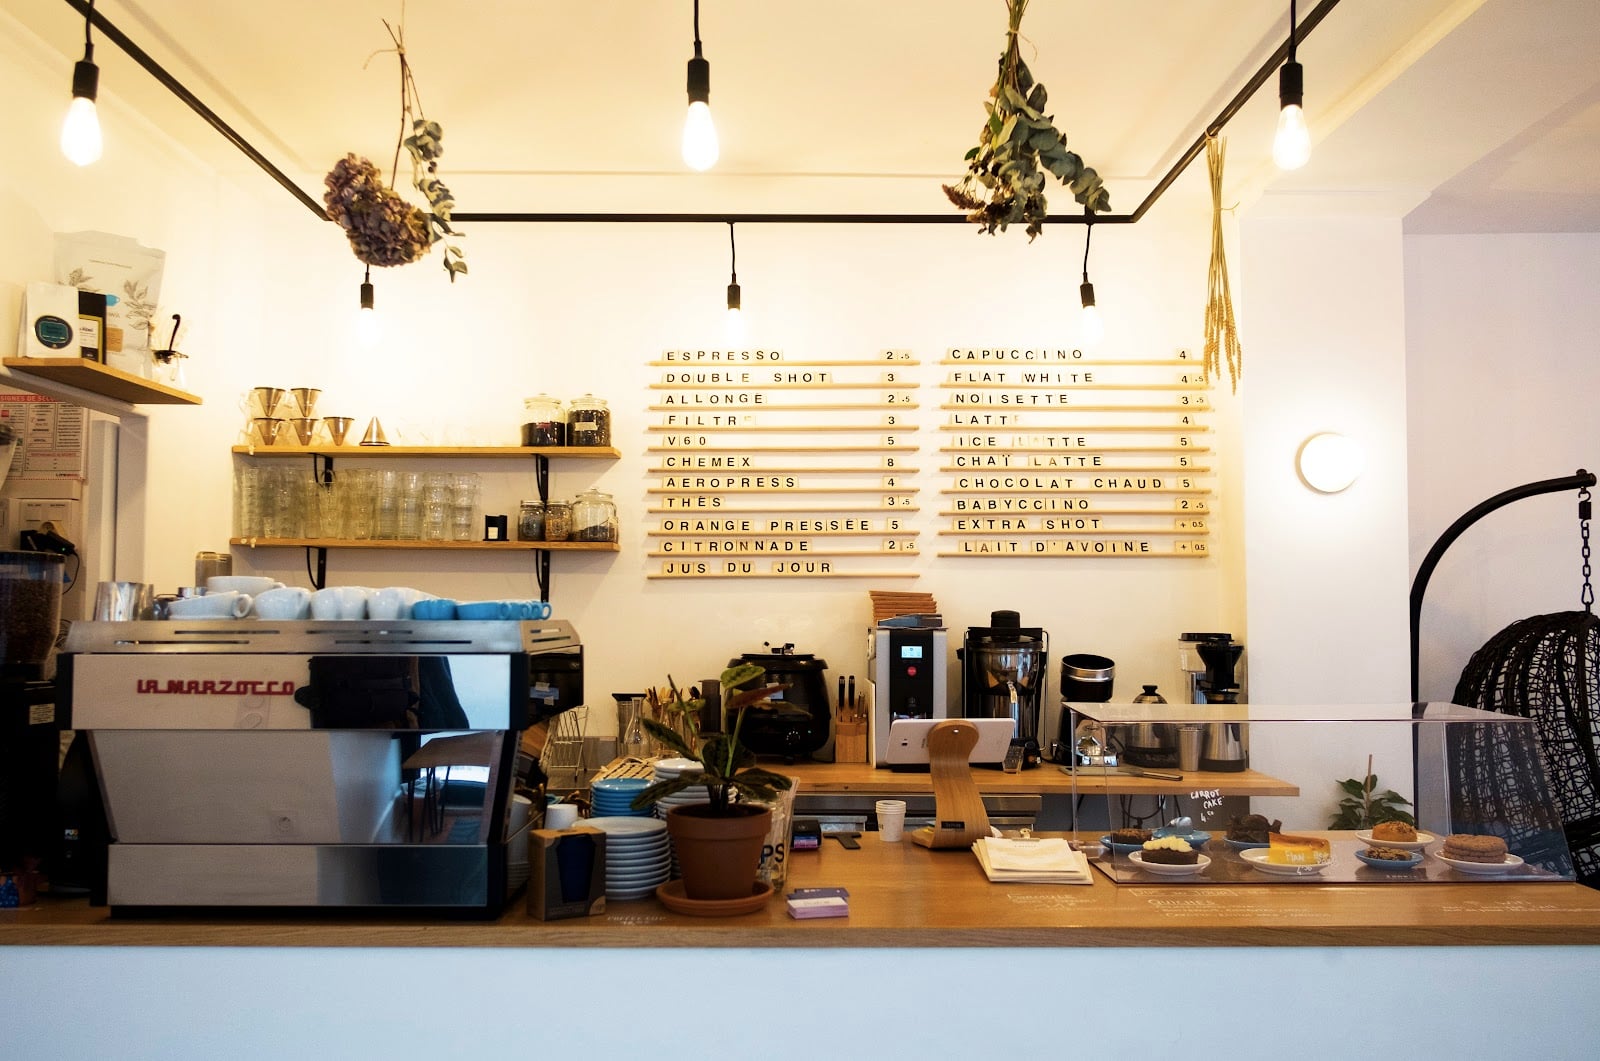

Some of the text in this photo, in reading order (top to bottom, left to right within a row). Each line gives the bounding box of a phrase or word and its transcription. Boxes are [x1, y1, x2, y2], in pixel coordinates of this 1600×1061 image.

[667, 350, 780, 361] ESPRESSO
[951, 349, 1082, 360] CAPUCCINO
[1179, 350, 1187, 360] 4
[666, 372, 827, 383] DOUBLE SHOT
[887, 373, 895, 382] 3
[954, 372, 1093, 383] FLAT WHITE
[665, 393, 763, 405] ALLONGE
[955, 393, 1068, 405] NOISETTE
[888, 416, 895, 425] 3
[1182, 416, 1189, 425] 4
[667, 436, 706, 446] V60
[887, 436, 895, 446] 5
[959, 436, 1086, 447] ICE LTTE
[1180, 437, 1188, 446] 5
[666, 457, 751, 467] CHEMEX
[887, 458, 895, 467] 8
[957, 454, 1102, 467] CHAÏ LATTE
[1180, 456, 1188, 467] 5
[666, 477, 795, 488] AEROPRESS
[887, 477, 895, 487] 4
[959, 477, 1162, 489] CHOCOLAT CHAUD
[1182, 478, 1190, 488] 5
[667, 496, 721, 507] THÉS
[957, 500, 1088, 510] BABYCCINO
[663, 518, 869, 532] ORANGE PRESSÉE
[890, 520, 898, 530] 5
[957, 517, 1100, 530] EXTRA SHOT
[663, 540, 808, 552] CITRONNADE
[964, 541, 1150, 553] LAIT D'AVOINE
[667, 562, 830, 573] JUS DU JOUR
[1190, 789, 1220, 799] CARROT
[760, 843, 785, 864] PS
